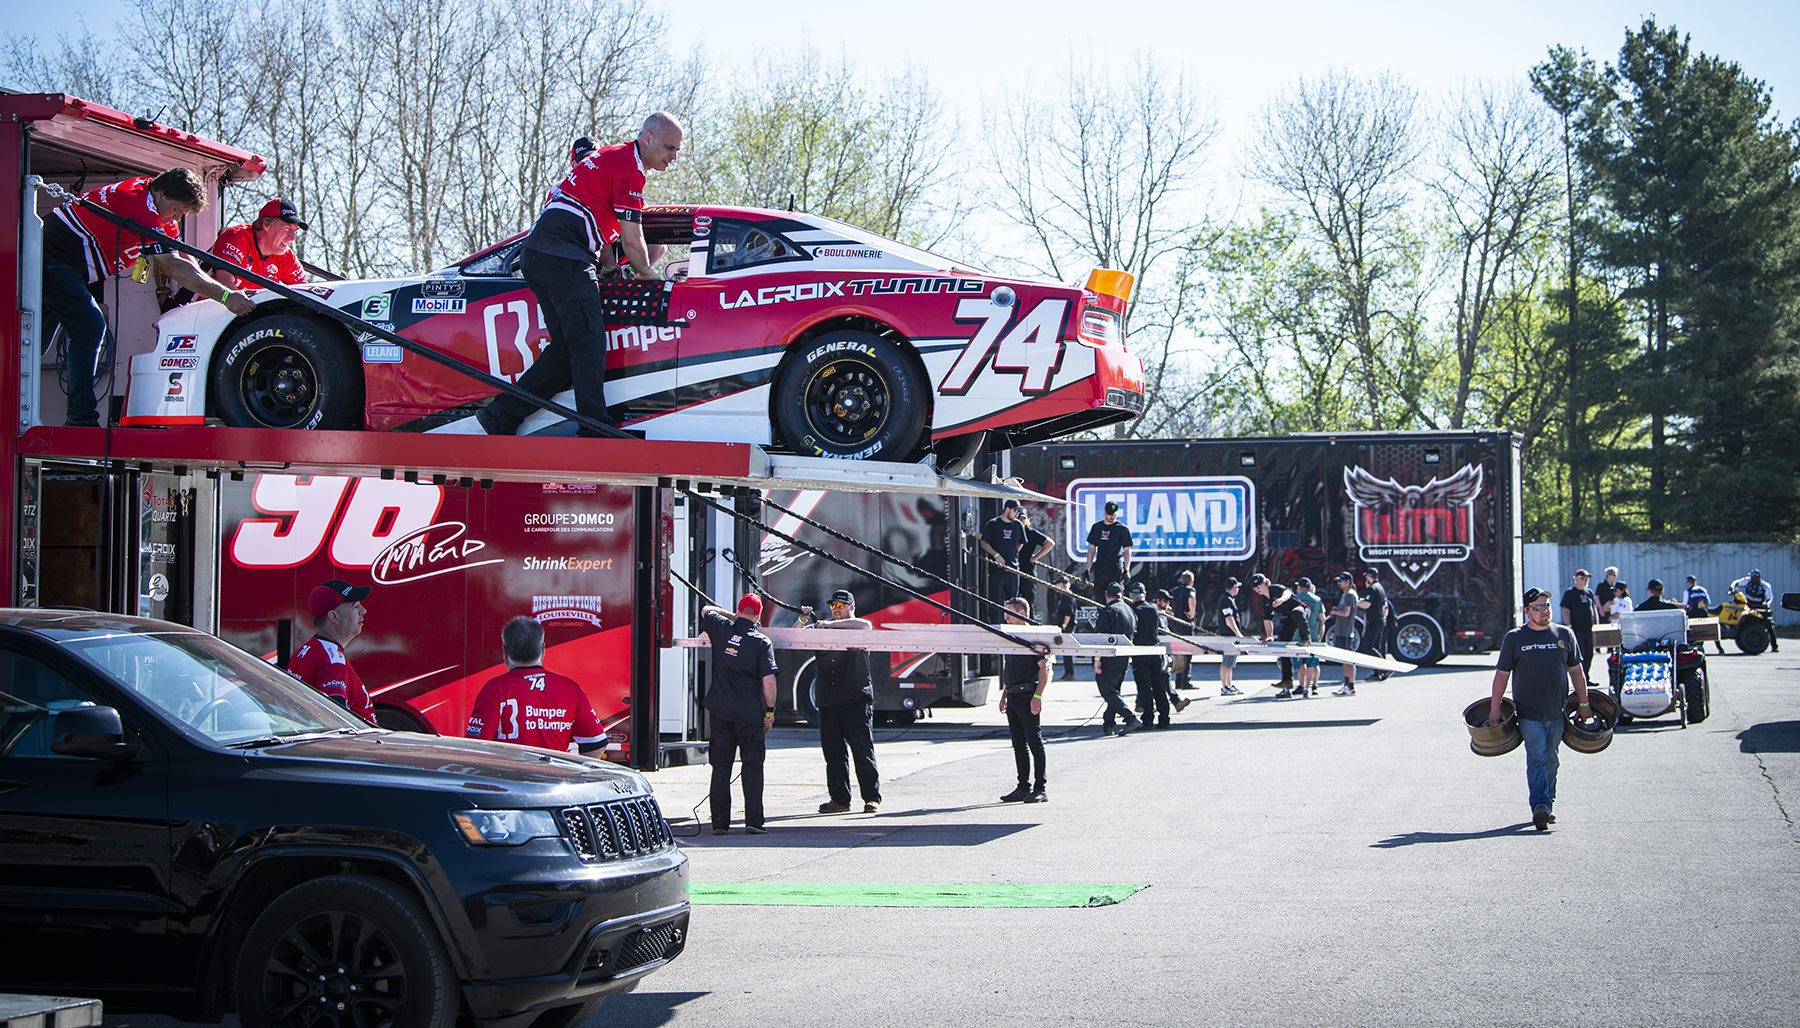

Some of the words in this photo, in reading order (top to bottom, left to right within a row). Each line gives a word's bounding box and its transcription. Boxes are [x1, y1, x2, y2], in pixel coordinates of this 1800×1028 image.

[823, 248, 882, 259] BOULONNERIE
[719, 280, 846, 310] LACROIX
[847, 278, 984, 295] TUNING
[415, 299, 449, 310] Mobil
[452, 299, 464, 310] 1
[166, 336, 197, 352] JE
[225, 328, 284, 366] GENERAL
[938, 297, 1073, 396] 74
[367, 347, 399, 357] LELAND
[806, 341, 877, 363] GENERAL
[161, 358, 190, 367] COMP
[23, 504, 37, 516] RTZ
[152, 510, 178, 523] QUARTZ
[1132, 537, 1197, 546] STRIES
[1204, 536, 1239, 545] INC.
[1368, 548, 1392, 556] WIGHT
[1393, 548, 1447, 556] MOTORSPORTS
[1447, 547, 1462, 555] INC.
[532, 595, 602, 613] DISTRIBUTIONS
[539, 611, 593, 620] LOUISEVILLE
[1521, 642, 1558, 651] carhartt
[528, 677, 546, 691] 74
[525, 705, 567, 720] Bumper
[469, 717, 484, 726] TAL
[525, 719, 536, 730] to
[537, 718, 573, 732] Bumper
